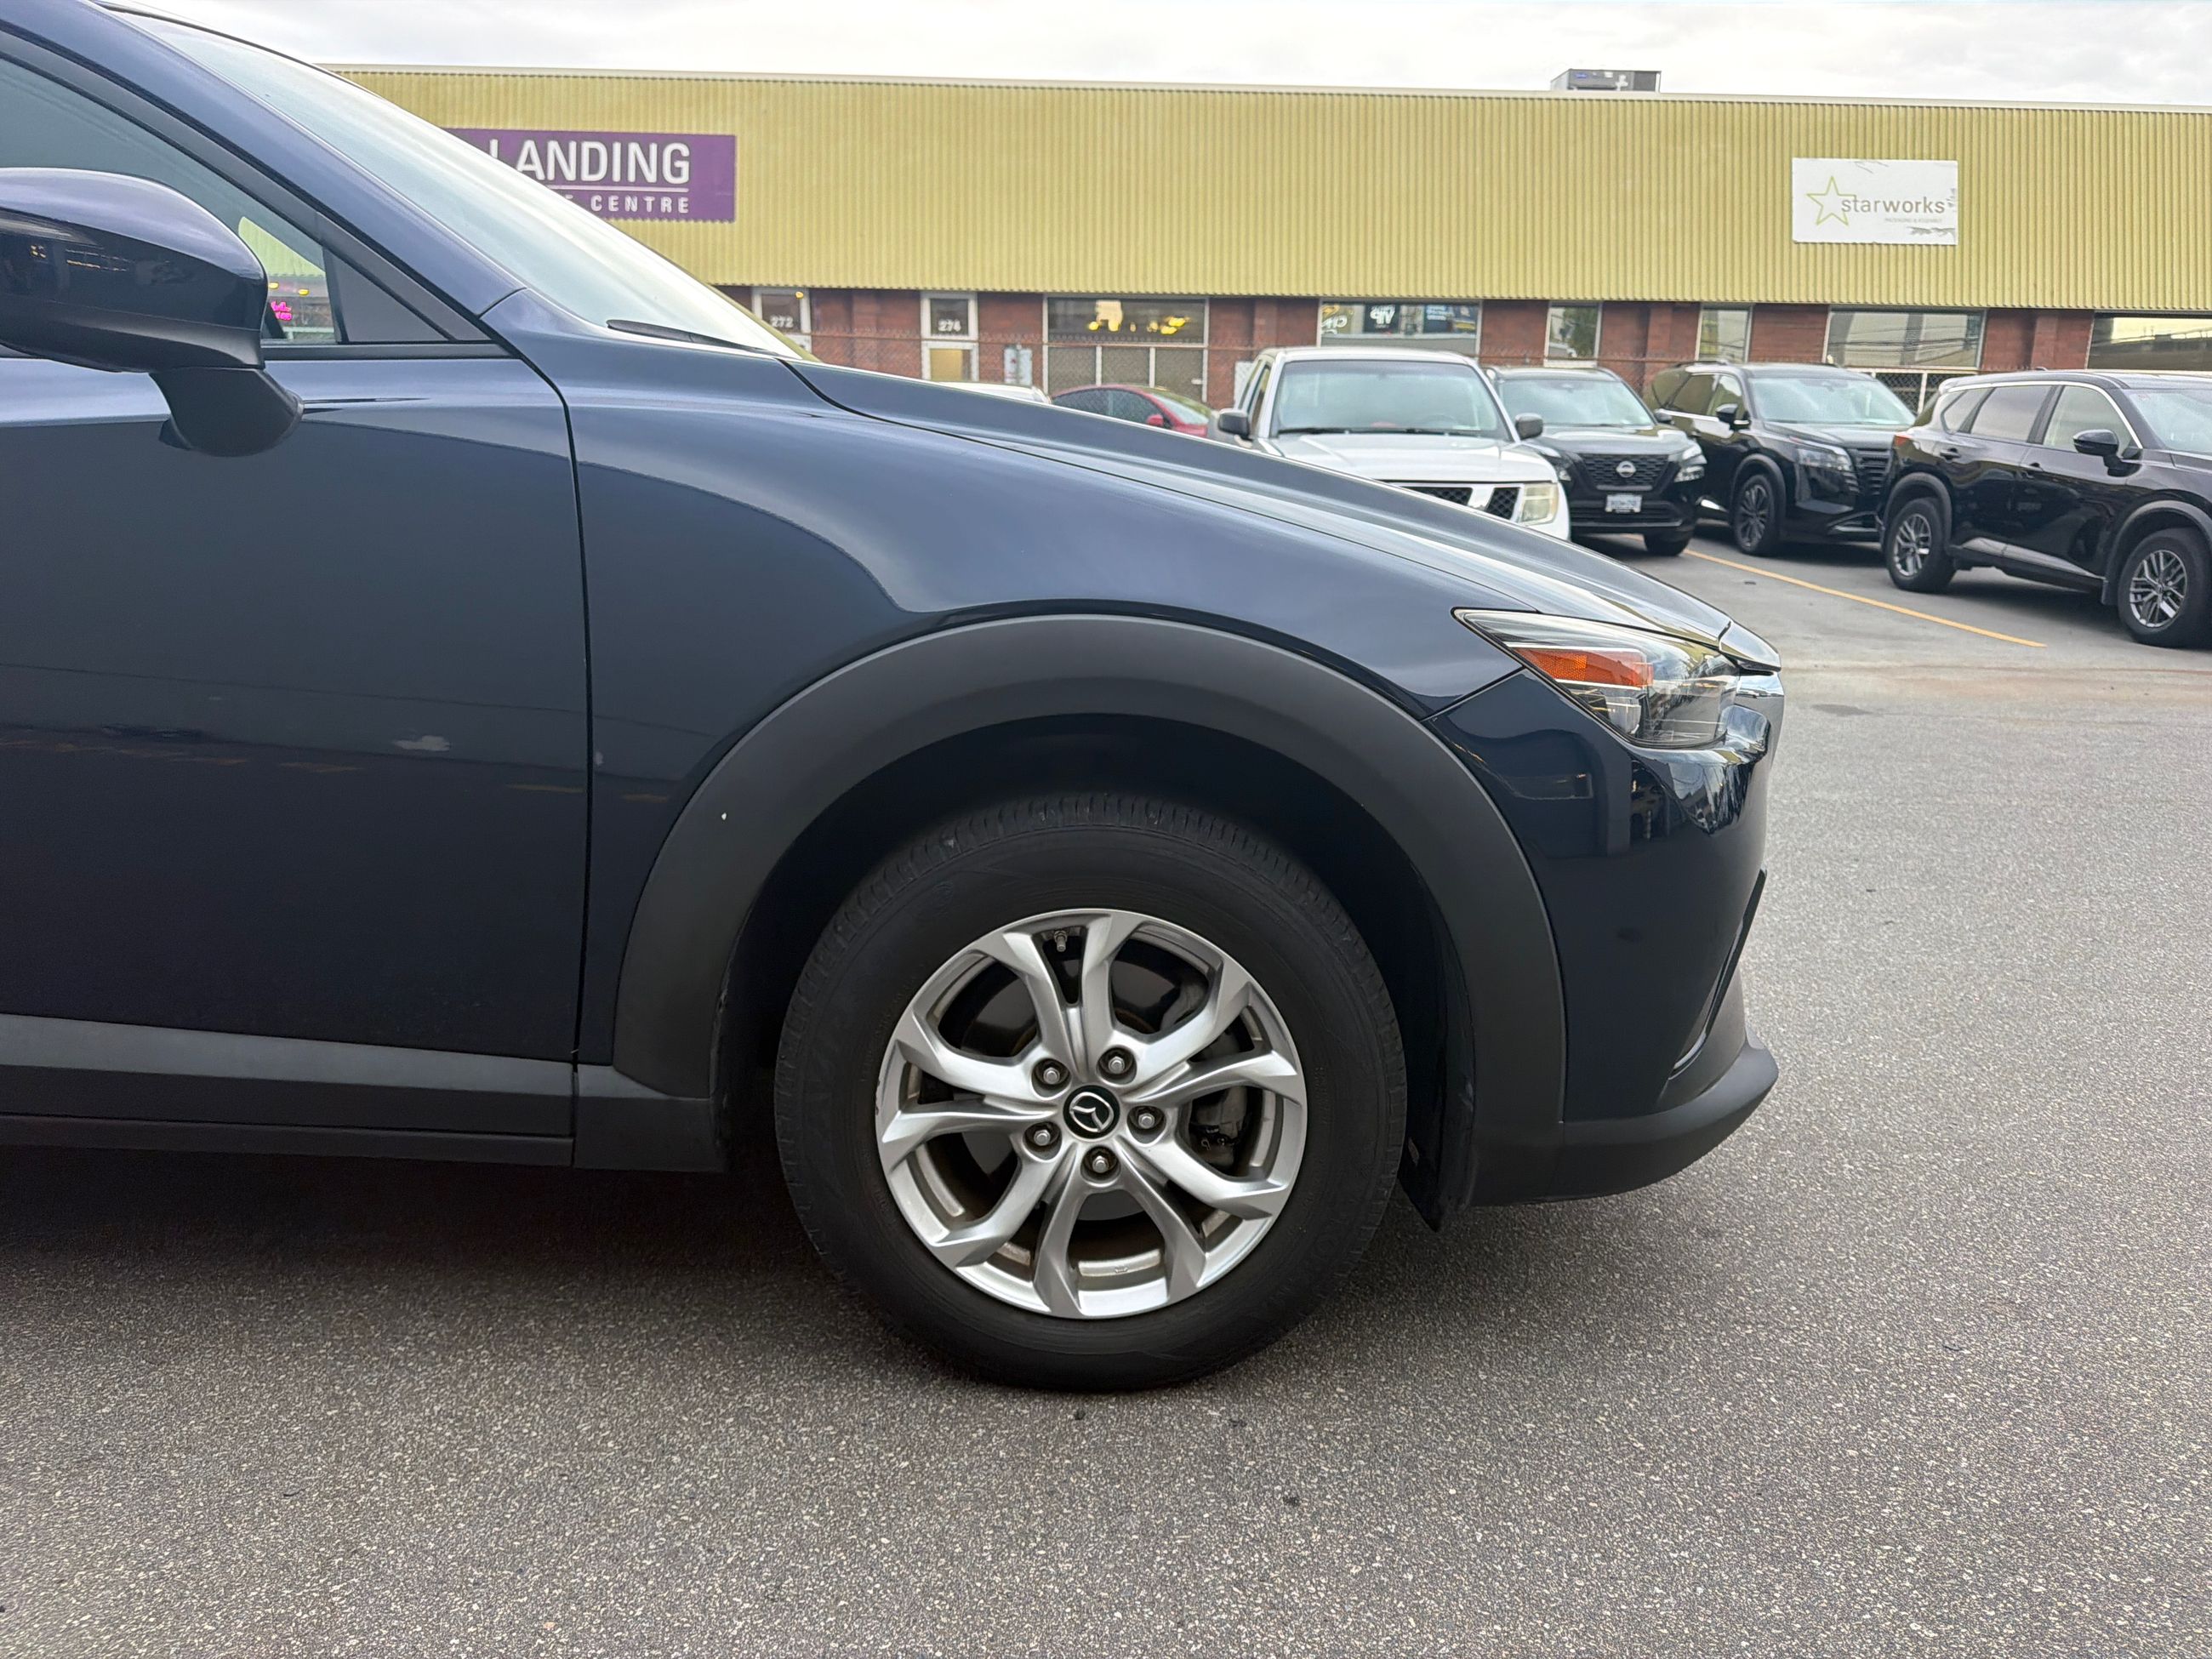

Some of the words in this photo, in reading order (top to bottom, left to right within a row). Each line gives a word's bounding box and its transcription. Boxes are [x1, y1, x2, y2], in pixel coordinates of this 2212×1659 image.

[590, 195, 689, 214] CENTRE
[1841, 196, 1946, 214] starworks
[770, 315, 794, 328] 272
